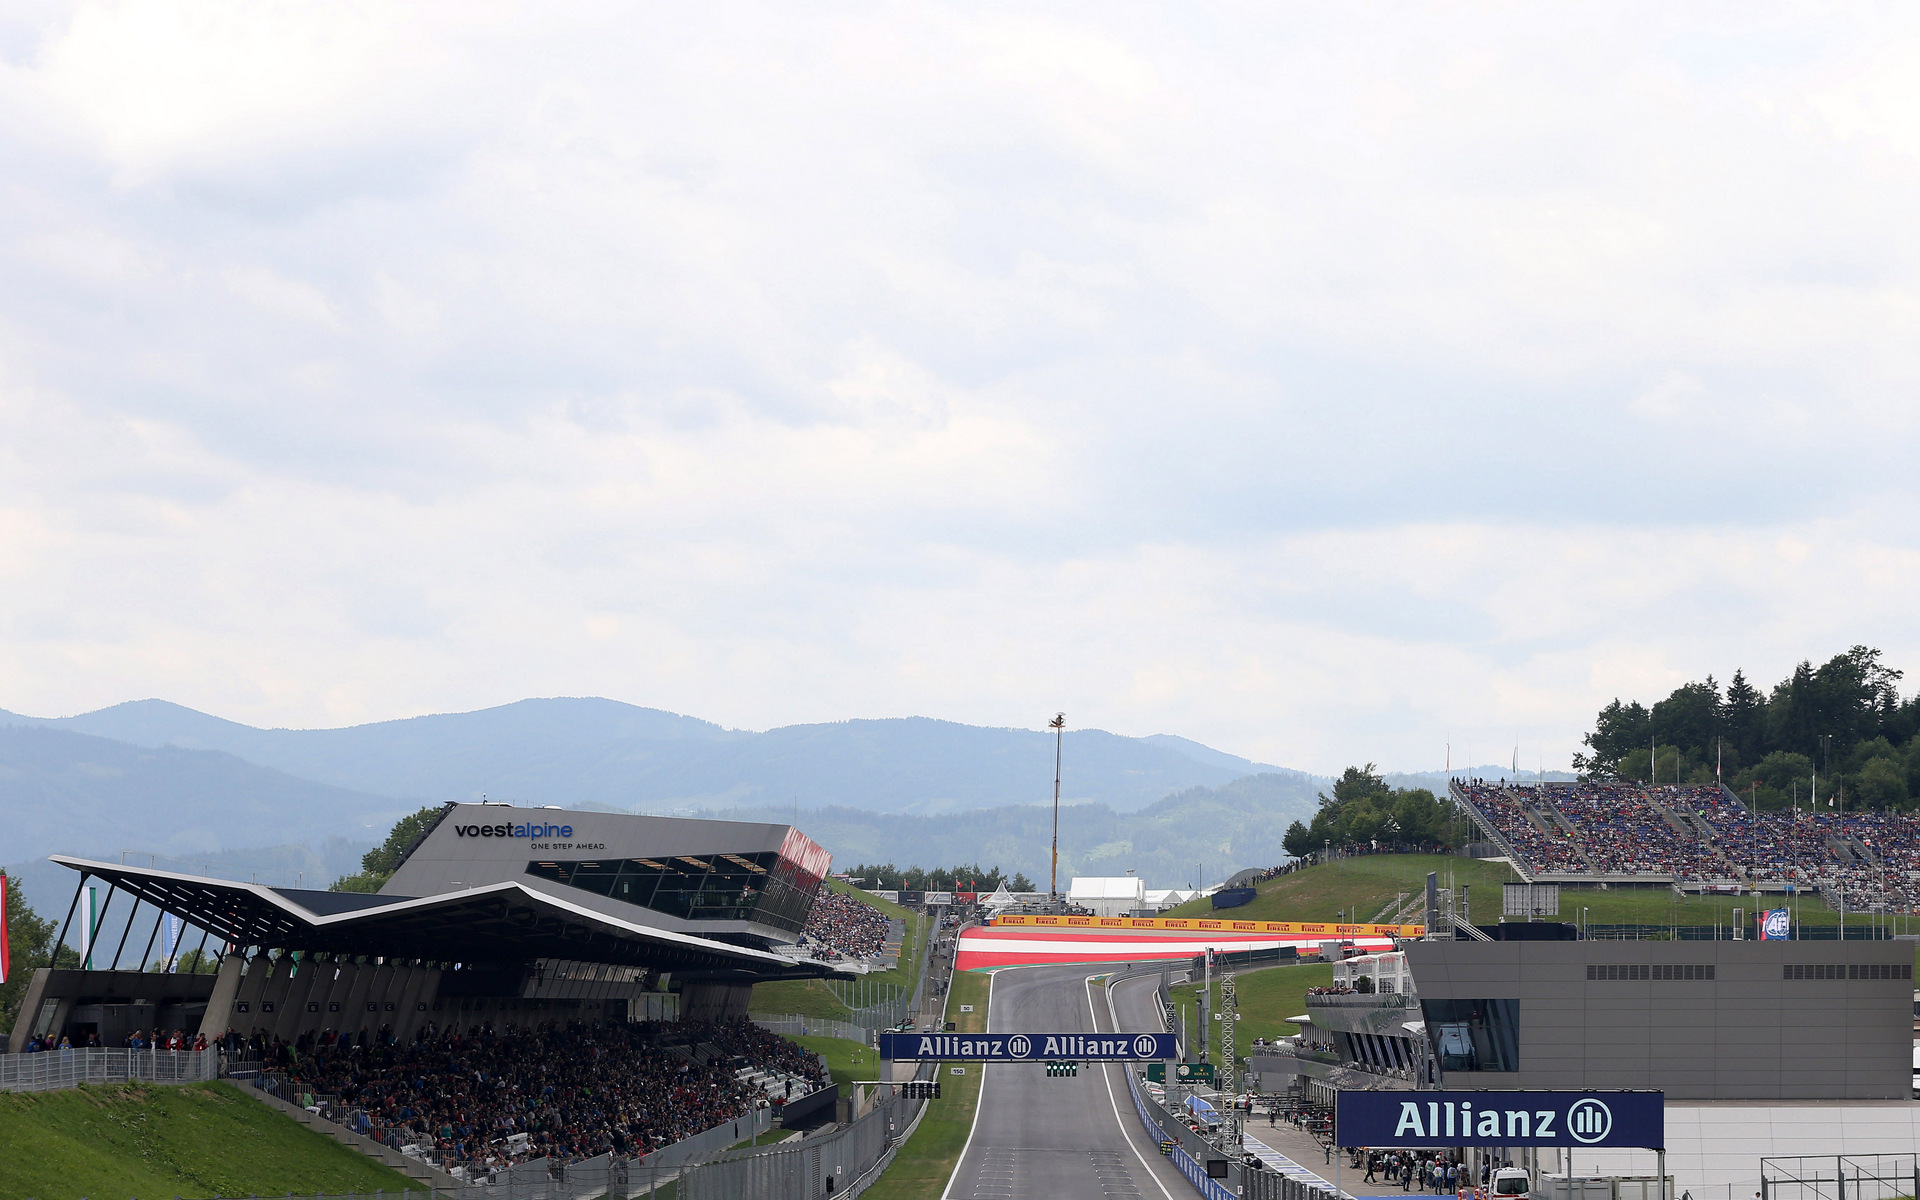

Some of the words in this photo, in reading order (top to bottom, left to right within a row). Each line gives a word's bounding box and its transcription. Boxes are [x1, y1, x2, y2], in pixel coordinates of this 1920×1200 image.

[455, 822, 573, 840] voestalpine
[1036, 917, 1057, 925] PIRELLI
[1165, 920, 1187, 928] PIRELLI
[1233, 922, 1255, 930] PIRELLI
[1266, 923, 1289, 931] PIRELLI
[1301, 924, 1325, 932] PIRELLI
[918, 1036, 1002, 1056] Allianz
[1043, 1036, 1128, 1056] Allianz
[1394, 1101, 1556, 1137] Allianz
